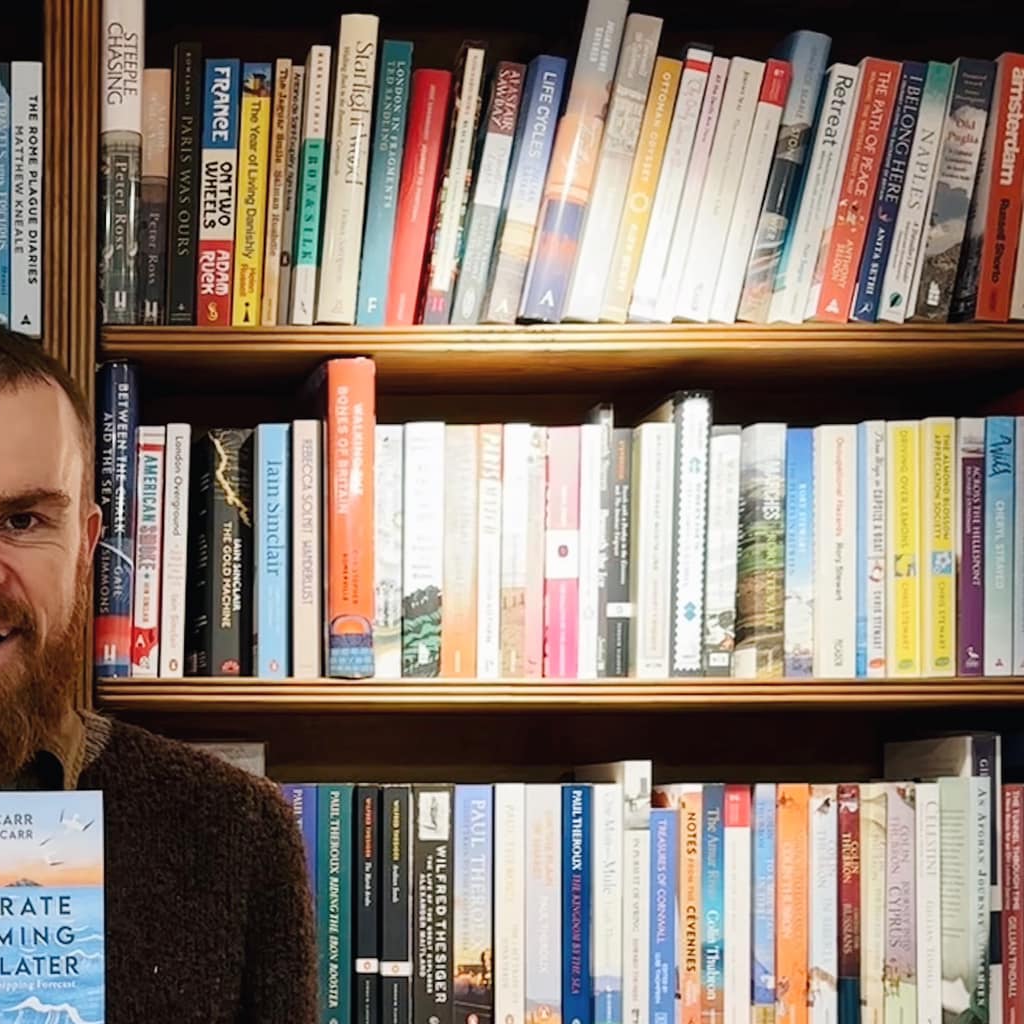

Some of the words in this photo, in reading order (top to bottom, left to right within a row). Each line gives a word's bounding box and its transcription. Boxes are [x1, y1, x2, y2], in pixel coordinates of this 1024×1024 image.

[108, 22, 122, 105] CHASING
[124, 32, 138, 96] STEEPLE
[28, 95, 38, 121] THE
[211, 66, 231, 142] FRANCE
[822, 75, 853, 148] Retreat
[15, 126, 24, 194] MATTHEW
[28, 126, 38, 163] ROME
[219, 162, 232, 183] ON
[28, 171, 38, 224] PLAGUE
[203, 162, 218, 229] WHEELS
[218, 187, 232, 226] TWO
[15, 199, 24, 255] KNEALE
[28, 229, 38, 285] DIARIES
[200, 251, 215, 295] RUCK
[215, 250, 230, 296] ADAM
[267, 460, 283, 498] Iain
[267, 503, 284, 576] Sinclair
[0, 830, 33, 839] CARR
[435, 846, 446, 915] WILFRED
[0, 957, 79, 975] LATER
[434, 922, 446, 1004] THESIGER
